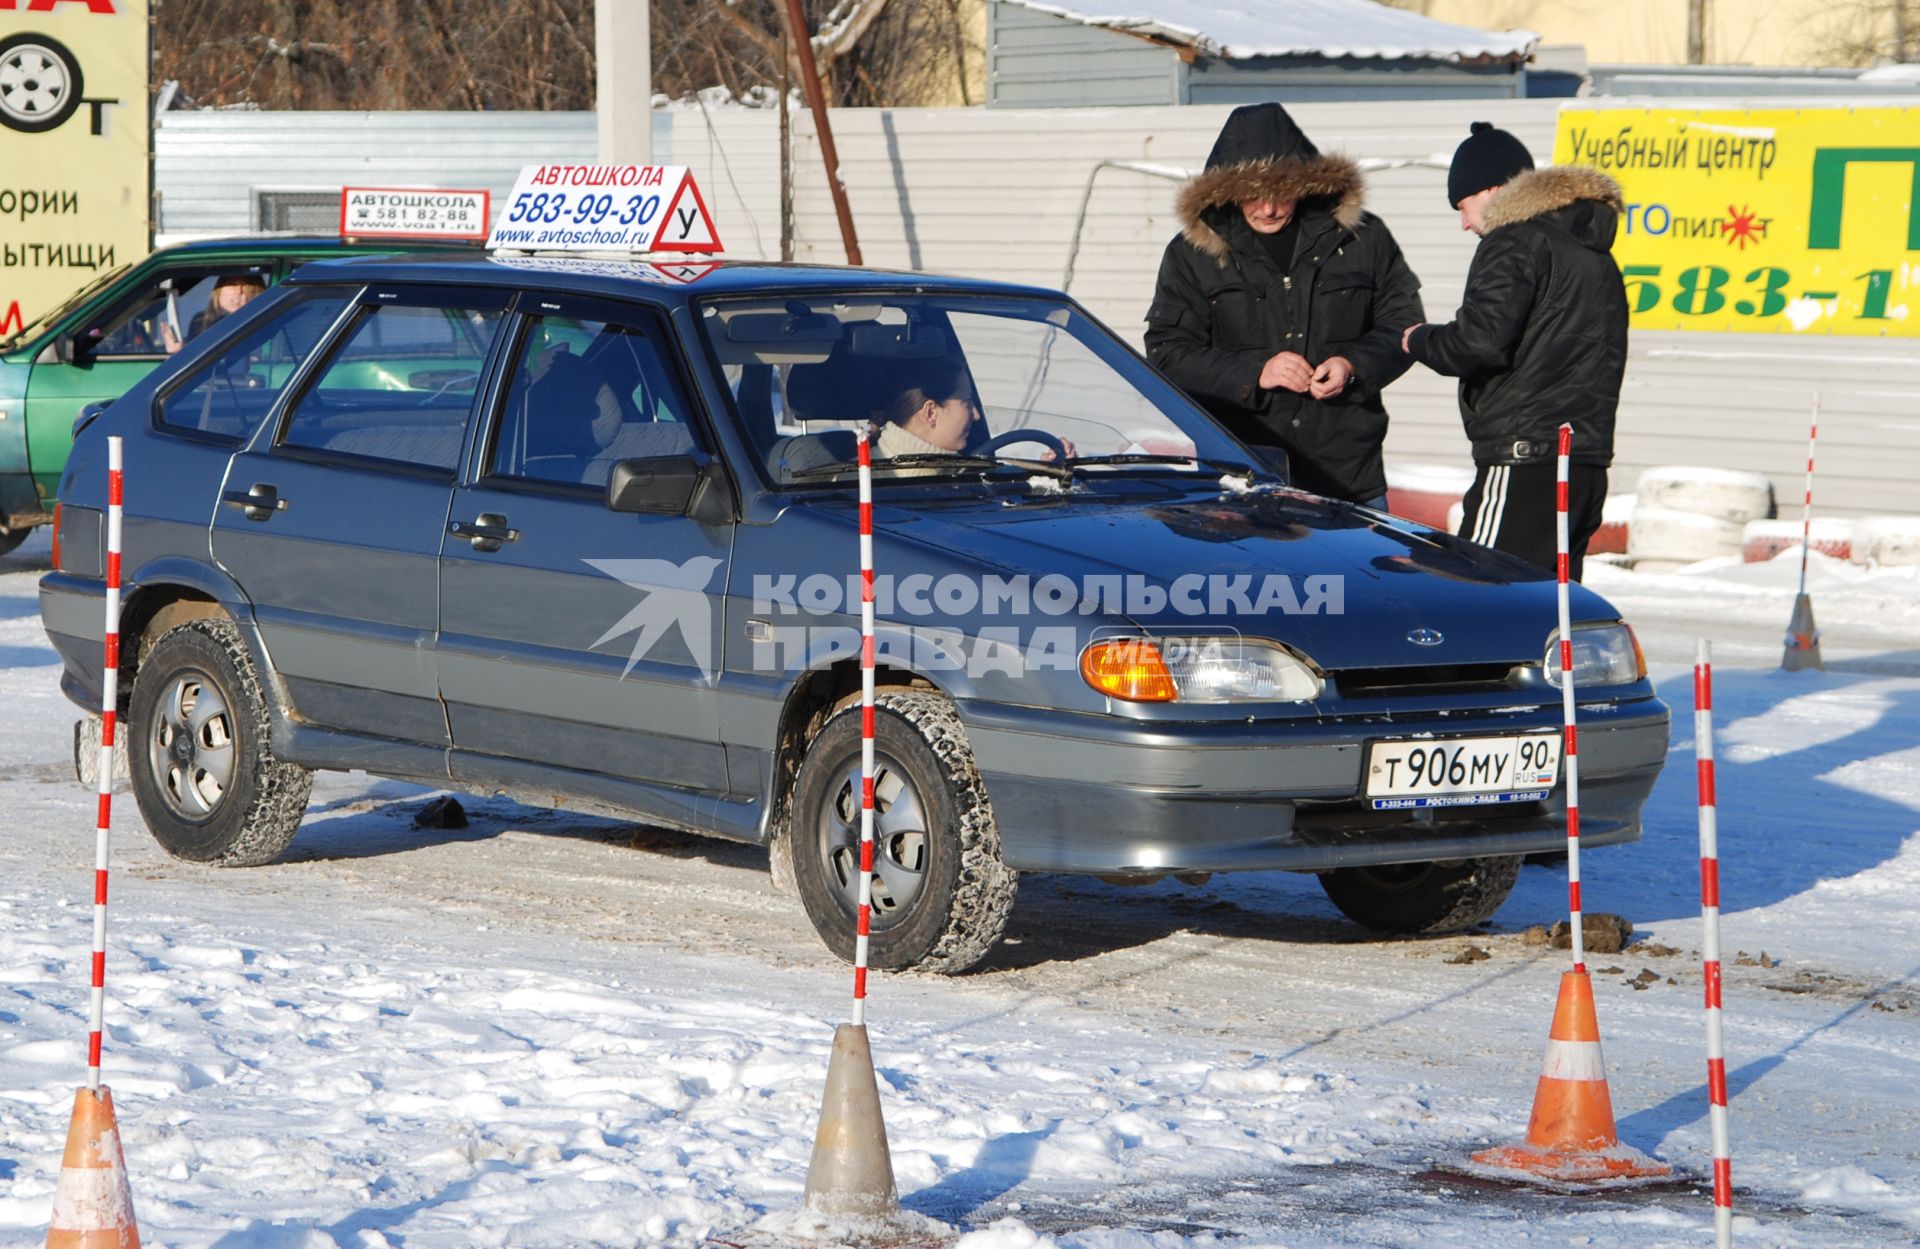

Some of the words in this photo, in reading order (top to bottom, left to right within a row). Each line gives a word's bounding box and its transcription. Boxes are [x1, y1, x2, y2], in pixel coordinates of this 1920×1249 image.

[1571, 126, 1687, 169] Учебный
[1697, 137, 1776, 180] центр
[531, 166, 664, 186] АВТОШКОЛА
[351, 195, 477, 208] АВТОШКОЛА
[509, 193, 660, 225] 583-99-30
[351, 220, 476, 230] www.voa1.ru
[377, 209, 407, 219] 581
[417, 210, 468, 221] 82-88
[677, 208, 697, 239] У
[495, 227, 649, 247] www.avtoschool.ru
[0, 244, 116, 270] ытищи
[1622, 265, 1893, 319] 583-1
[1386, 747, 1509, 788] Т906МУ
[1520, 741, 1548, 770] 90
[1515, 772, 1536, 783] RUS
